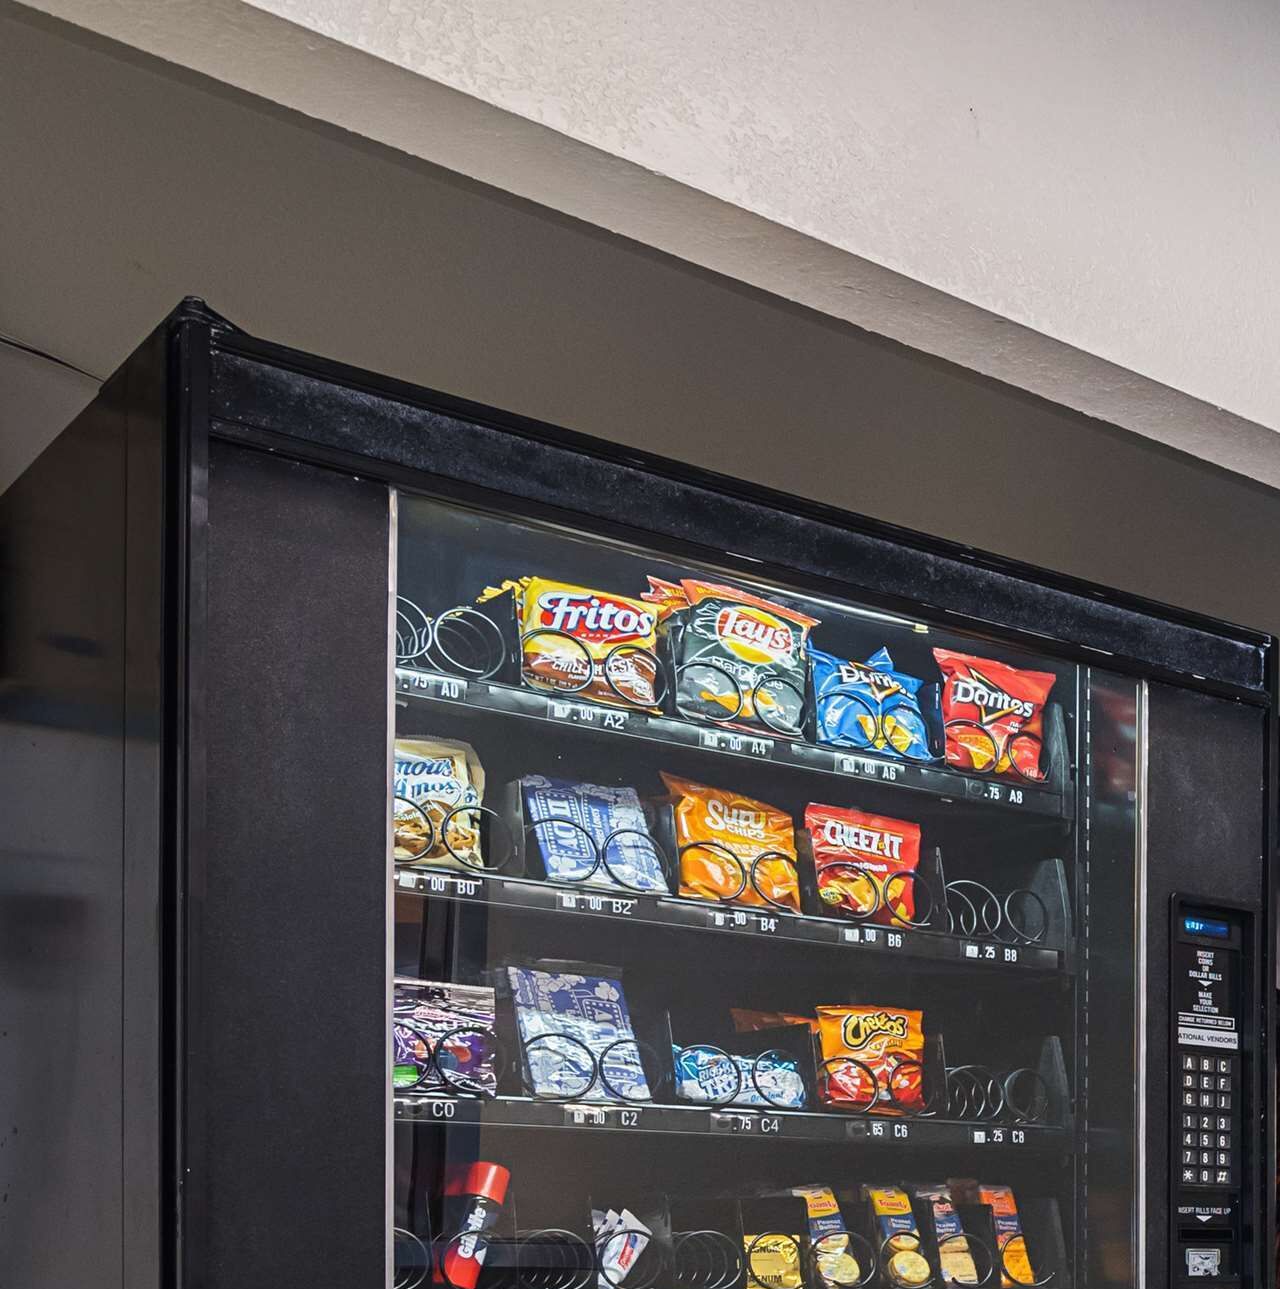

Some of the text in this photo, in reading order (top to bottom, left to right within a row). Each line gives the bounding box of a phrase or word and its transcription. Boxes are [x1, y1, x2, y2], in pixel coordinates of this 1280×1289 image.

[538, 591, 653, 635] Fritos
[441, 682, 458, 698] A0
[956, 681, 1034, 718] Doritos
[604, 714, 624, 729] A2
[752, 742, 766, 755] A4
[883, 767, 896, 780] A6
[1009, 790, 1022, 804] A8
[457, 881, 475, 895] B0
[613, 900, 631, 915] B2
[760, 917, 776, 932] B4
[888, 933, 902, 948] B6
[1004, 948, 1017, 962] B8
[843, 1011, 907, 1048] Cheetos
[1206, 1034, 1237, 1045] VENDORS
[1186, 1057, 1226, 1072] A B C
[1186, 1075, 1226, 1089] D E F
[1186, 1094, 1225, 1107] G H J
[432, 1102, 455, 1118] C0
[621, 1112, 637, 1126] C2
[761, 1118, 779, 1132] C4
[1186, 1116, 1225, 1128] 1 2 3
[894, 1124, 908, 1138] C6
[1012, 1130, 1025, 1144] C8
[1185, 1134, 1225, 1146] 4 5 6
[1185, 1152, 1225, 1164] 7 8 9
[1203, 1171, 1208, 1181] 0
[1223, 1207, 1232, 1215] UP
